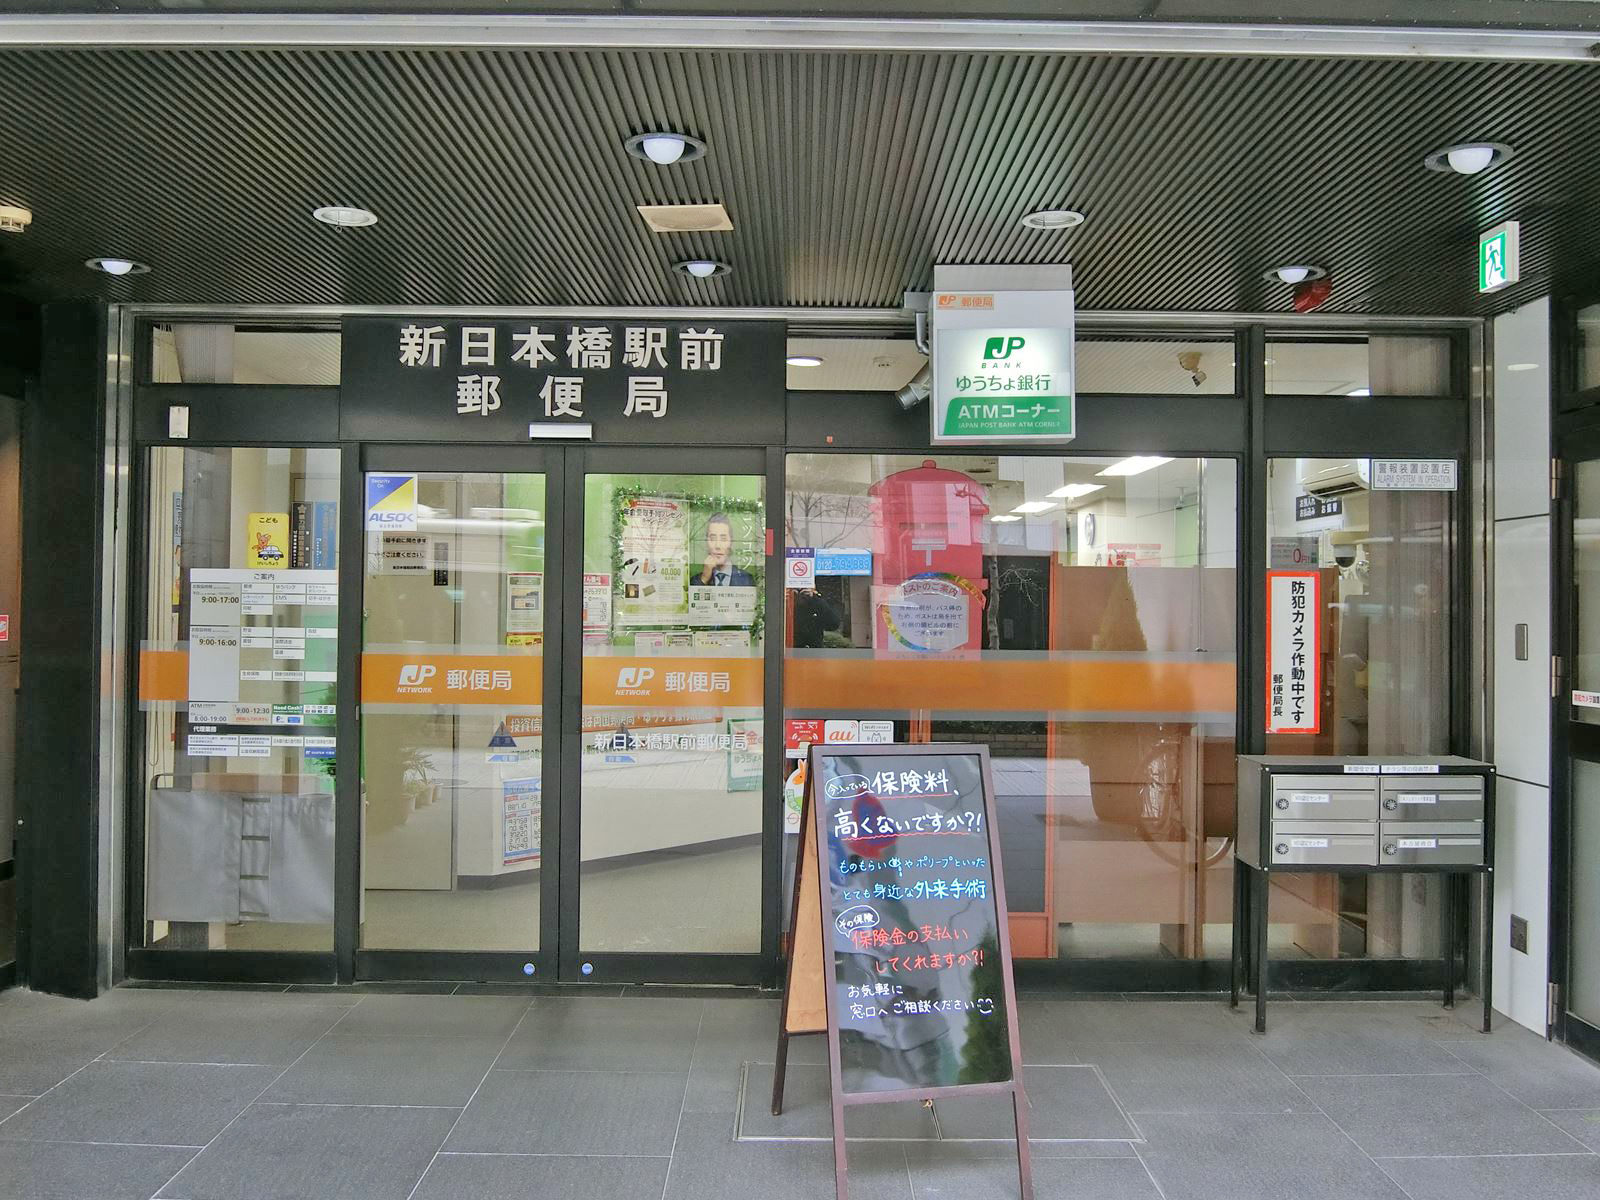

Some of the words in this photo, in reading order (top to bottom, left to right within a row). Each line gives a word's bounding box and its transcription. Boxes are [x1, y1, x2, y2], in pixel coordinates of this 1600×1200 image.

[399, 325, 725, 370] 新日本橋駅前
[983, 336, 1026, 360] JP
[956, 374, 1051, 391] ゆうちょ銀行
[456, 375, 669, 418] 郵便局
[958, 403, 1060, 419] ATMコーナー
[369, 513, 413, 522] ALSOK
[253, 573, 275, 581] ご案内
[201, 596, 240, 604] 9:00-17:00
[199, 639, 237, 647] 9:00-16:00
[1291, 581, 1305, 724] 防犯カメラ作動中です
[446, 668, 513, 692] 郵便局
[665, 671, 731, 693] 郵便局
[396, 686, 433, 694] NETWORK
[1272, 674, 1284, 717] 郵便局長
[511, 717, 541, 733] 投資信
[594, 733, 749, 751] 新日本橋駅前郵便局
[829, 730, 855, 741] au
[872, 768, 960, 796] 保険料、
[834, 808, 982, 838] 高くないですか?!
[839, 861, 886, 874] ものもらい
[904, 855, 986, 869] やポリープといった
[843, 878, 987, 900] とても身近な外来手術
[838, 913, 876, 930] その保険
[851, 924, 969, 950] 保険金の支払い
[876, 950, 984, 974] してくれますか?!
[847, 982, 904, 998] お気軽に
